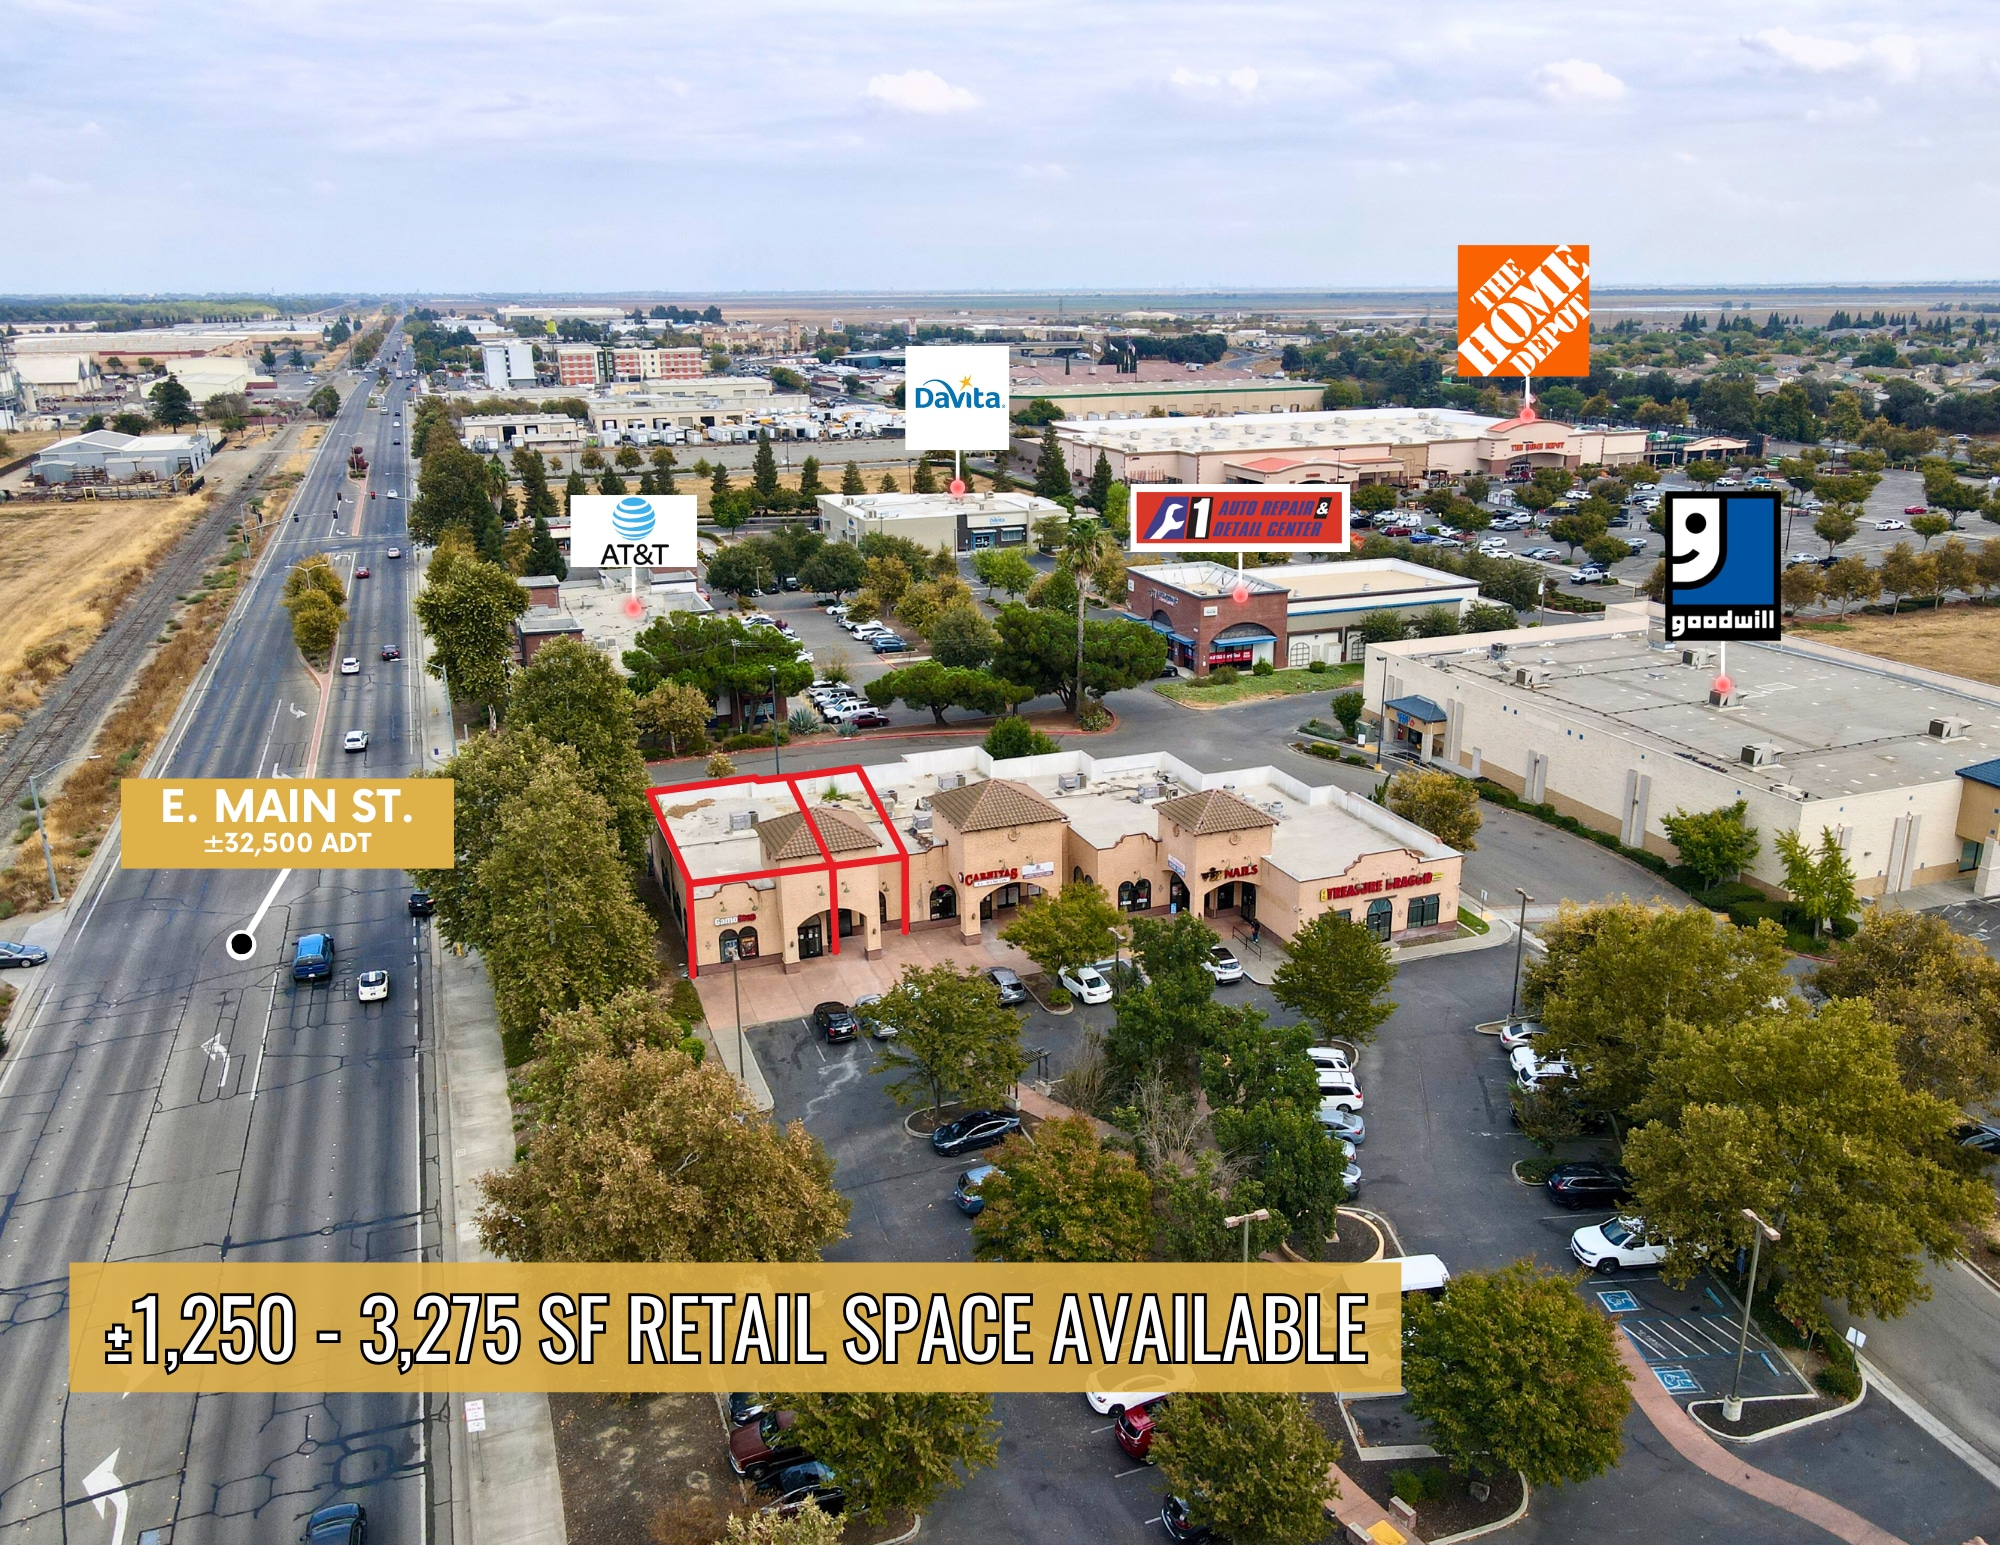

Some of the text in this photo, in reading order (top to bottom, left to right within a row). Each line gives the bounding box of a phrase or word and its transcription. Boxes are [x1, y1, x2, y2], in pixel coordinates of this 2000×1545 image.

[1224, 864, 1258, 879] NAILS
[1327, 880, 1383, 900] TREASURE
[1385, 872, 1433, 890] DRAGON
